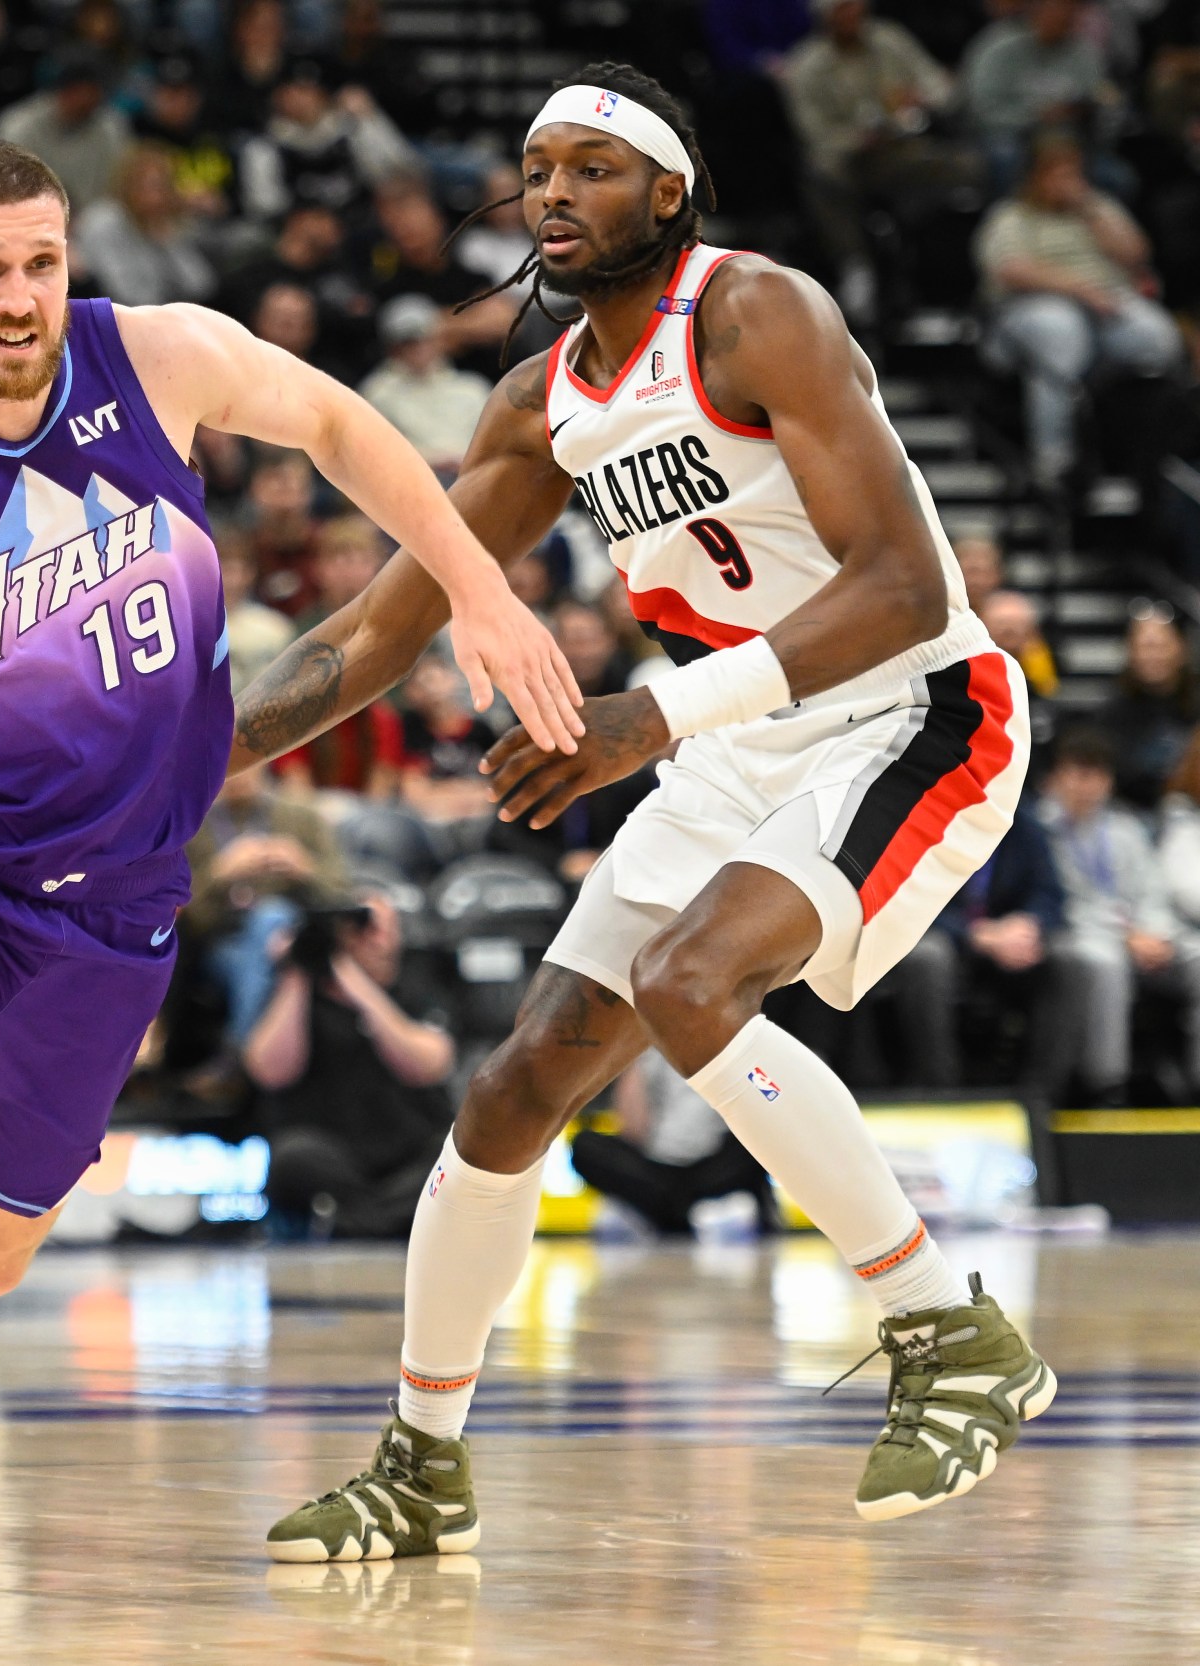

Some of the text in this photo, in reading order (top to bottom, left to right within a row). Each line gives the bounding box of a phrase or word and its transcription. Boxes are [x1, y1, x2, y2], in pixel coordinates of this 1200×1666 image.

[68, 400, 120, 446] LVT
[636, 375, 682, 400] BRIGHTSIDE
[573, 434, 730, 545] BLAZERS
[685, 517, 753, 592] 9
[80, 579, 177, 691] 19
